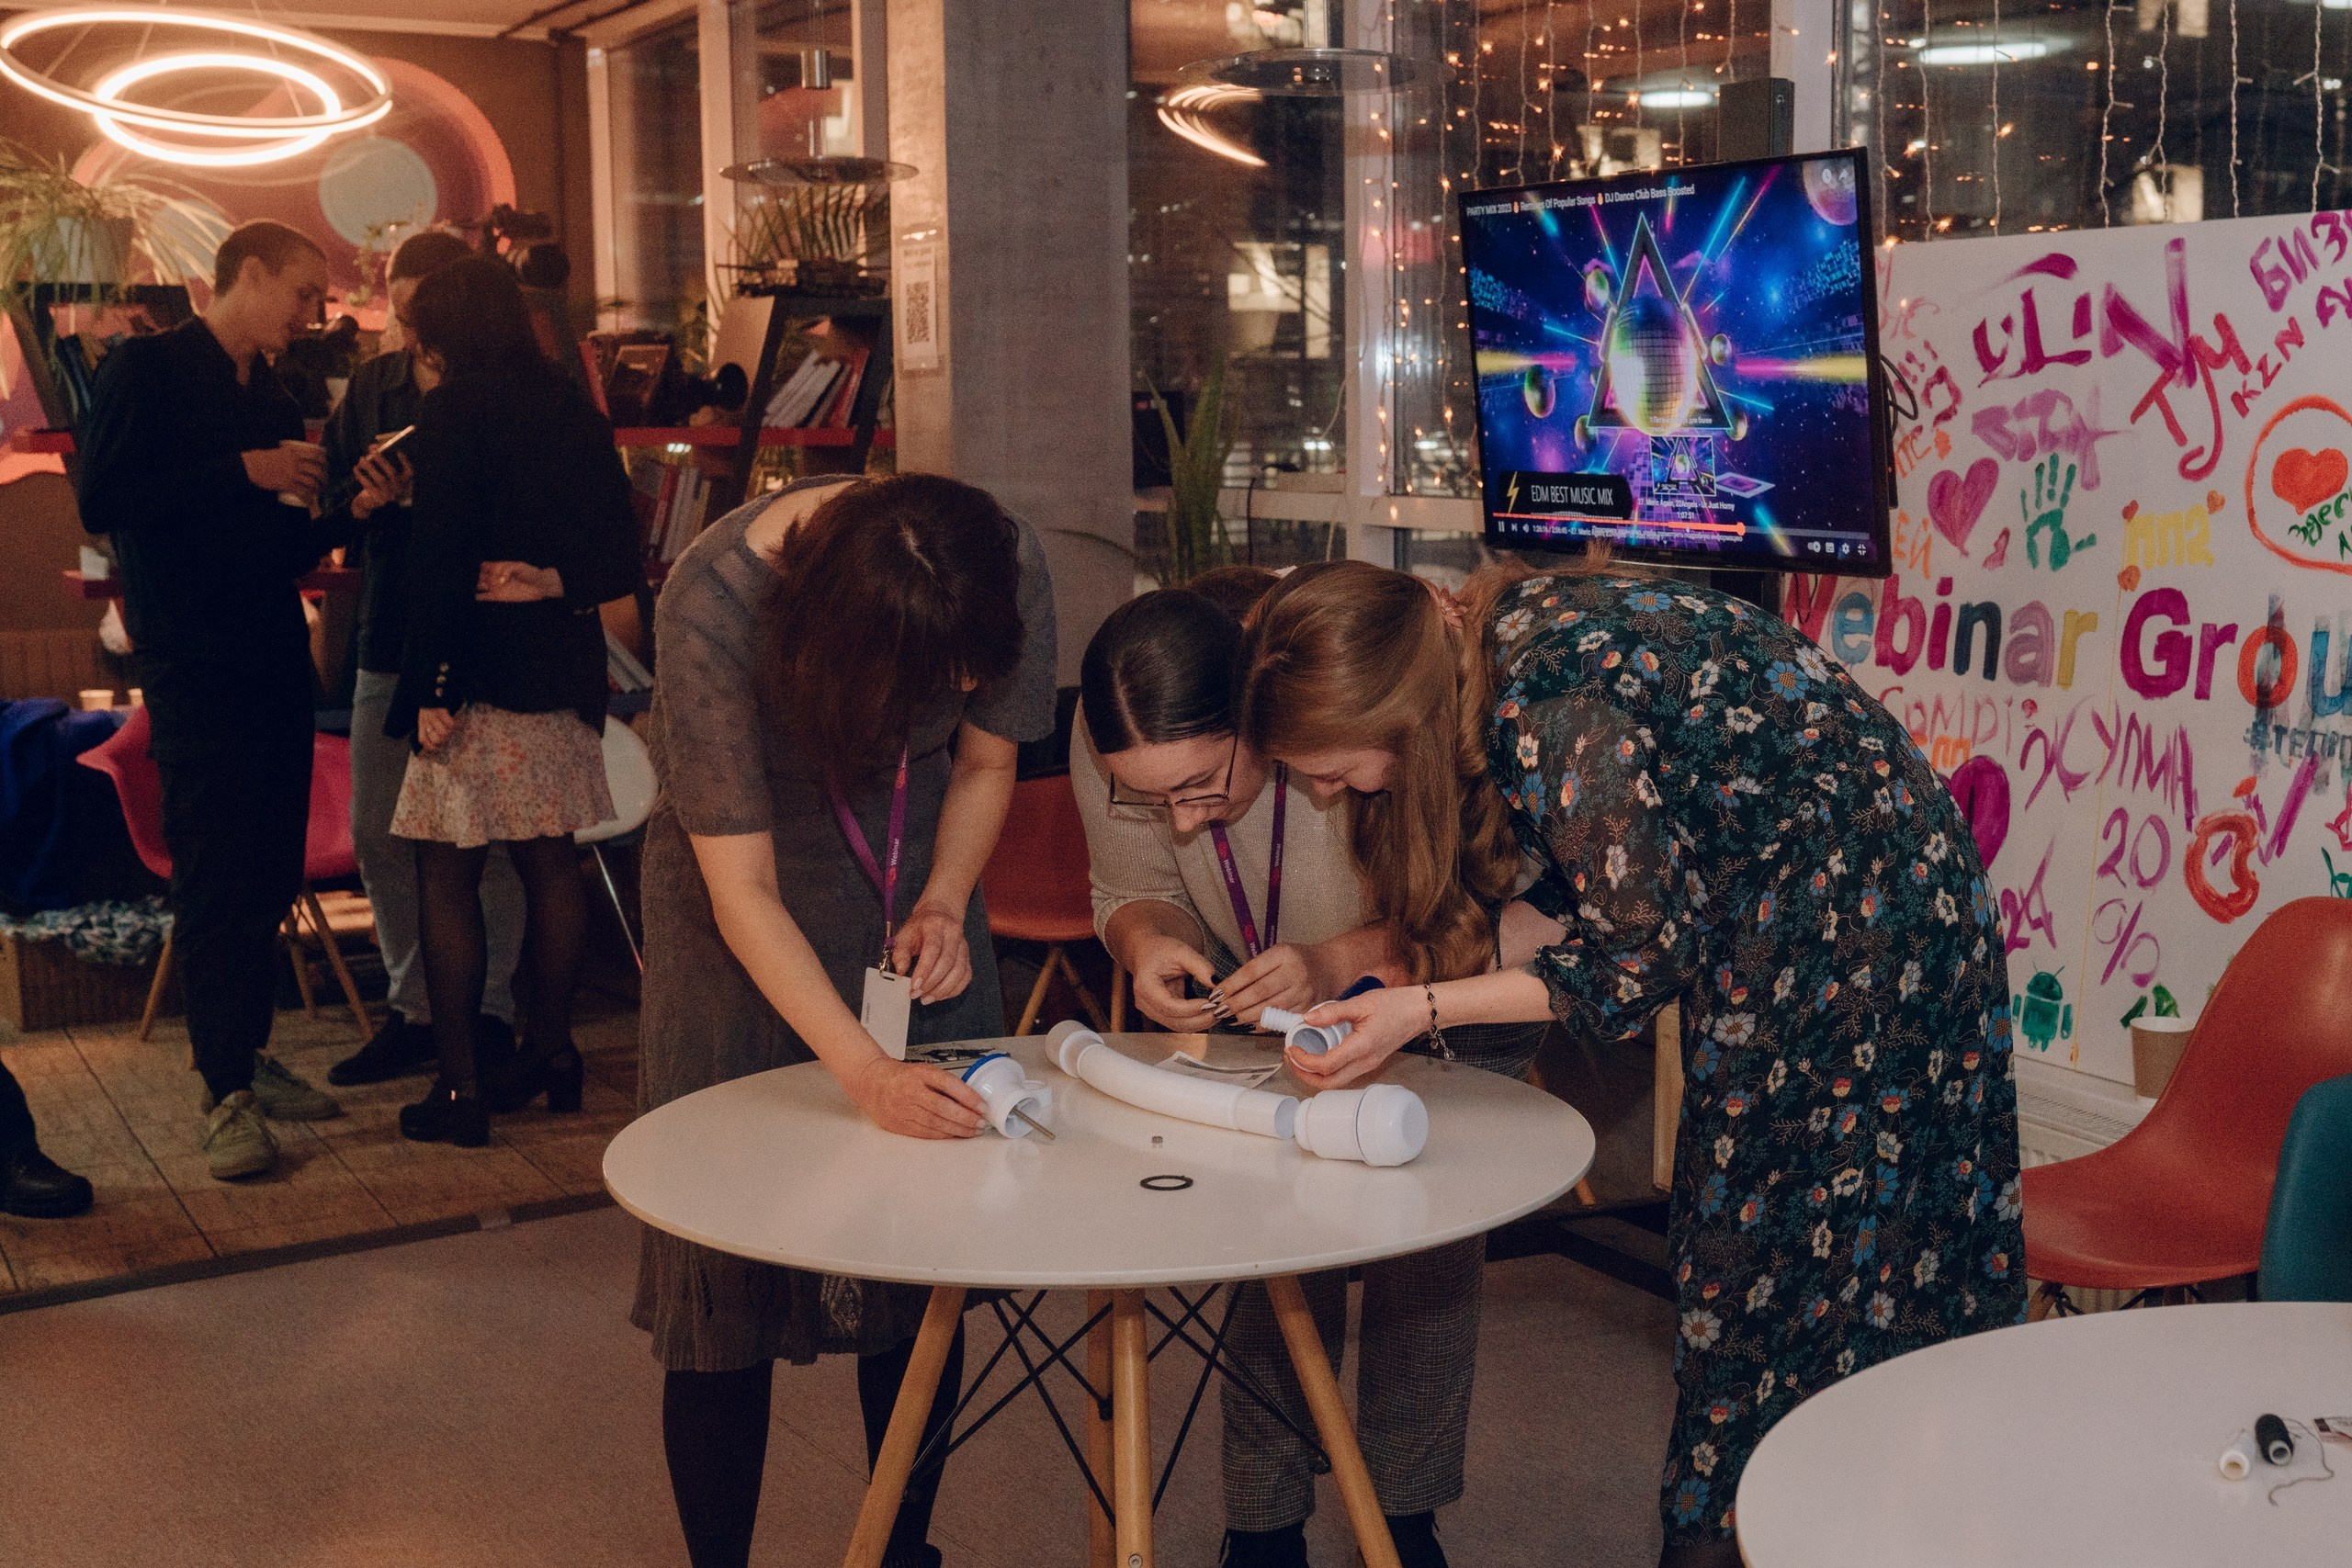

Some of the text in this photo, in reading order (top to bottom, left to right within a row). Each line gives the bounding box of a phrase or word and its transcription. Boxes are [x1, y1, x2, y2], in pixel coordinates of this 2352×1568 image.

[1466, 207, 1485, 217] PARTY
[1486, 205, 1497, 215] MIX
[1498, 203, 1512, 213] 2023
[1545, 197, 1553, 208] Of
[1553, 197, 1576, 209] Popular
[1577, 195, 1596, 207] Songs
[1605, 191, 1614, 203] DJ
[1615, 190, 1634, 201] Dance
[1635, 188, 1650, 200] Club
[1651, 186, 1667, 198] Bass
[1668, 185, 1695, 197] Boosted
[1531, 485, 1613, 505] EDM BEST MUSIC MIX
[890, 838, 899, 866] Webinar
[2097, 807, 2171, 889] 20
[1223, 859, 1235, 884] Webinar
